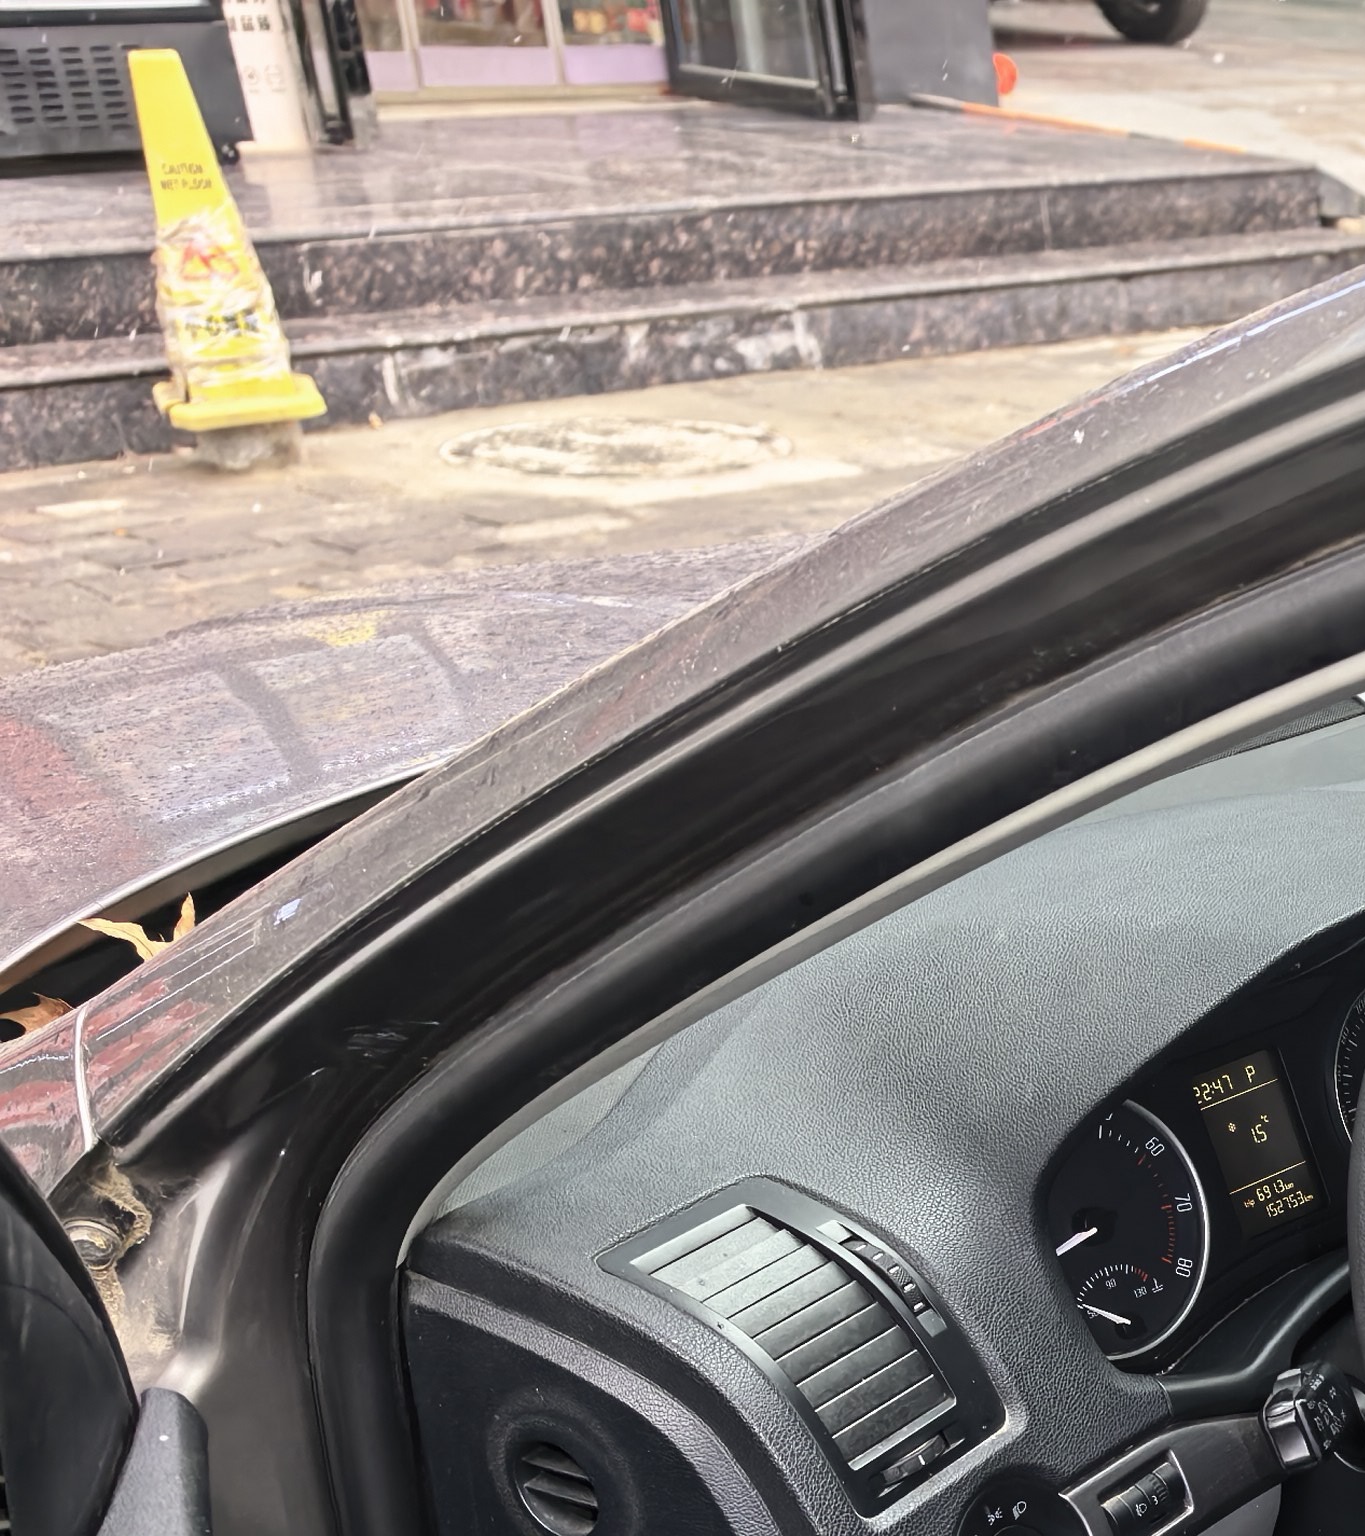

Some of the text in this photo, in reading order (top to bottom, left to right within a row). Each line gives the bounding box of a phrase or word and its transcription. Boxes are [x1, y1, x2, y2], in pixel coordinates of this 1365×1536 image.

[1244, 1065, 1256, 1083] P
[1144, 1136, 1165, 1157] 60
[1174, 1193, 1193, 1213] 70
[1175, 1257, 1193, 1278] 80
